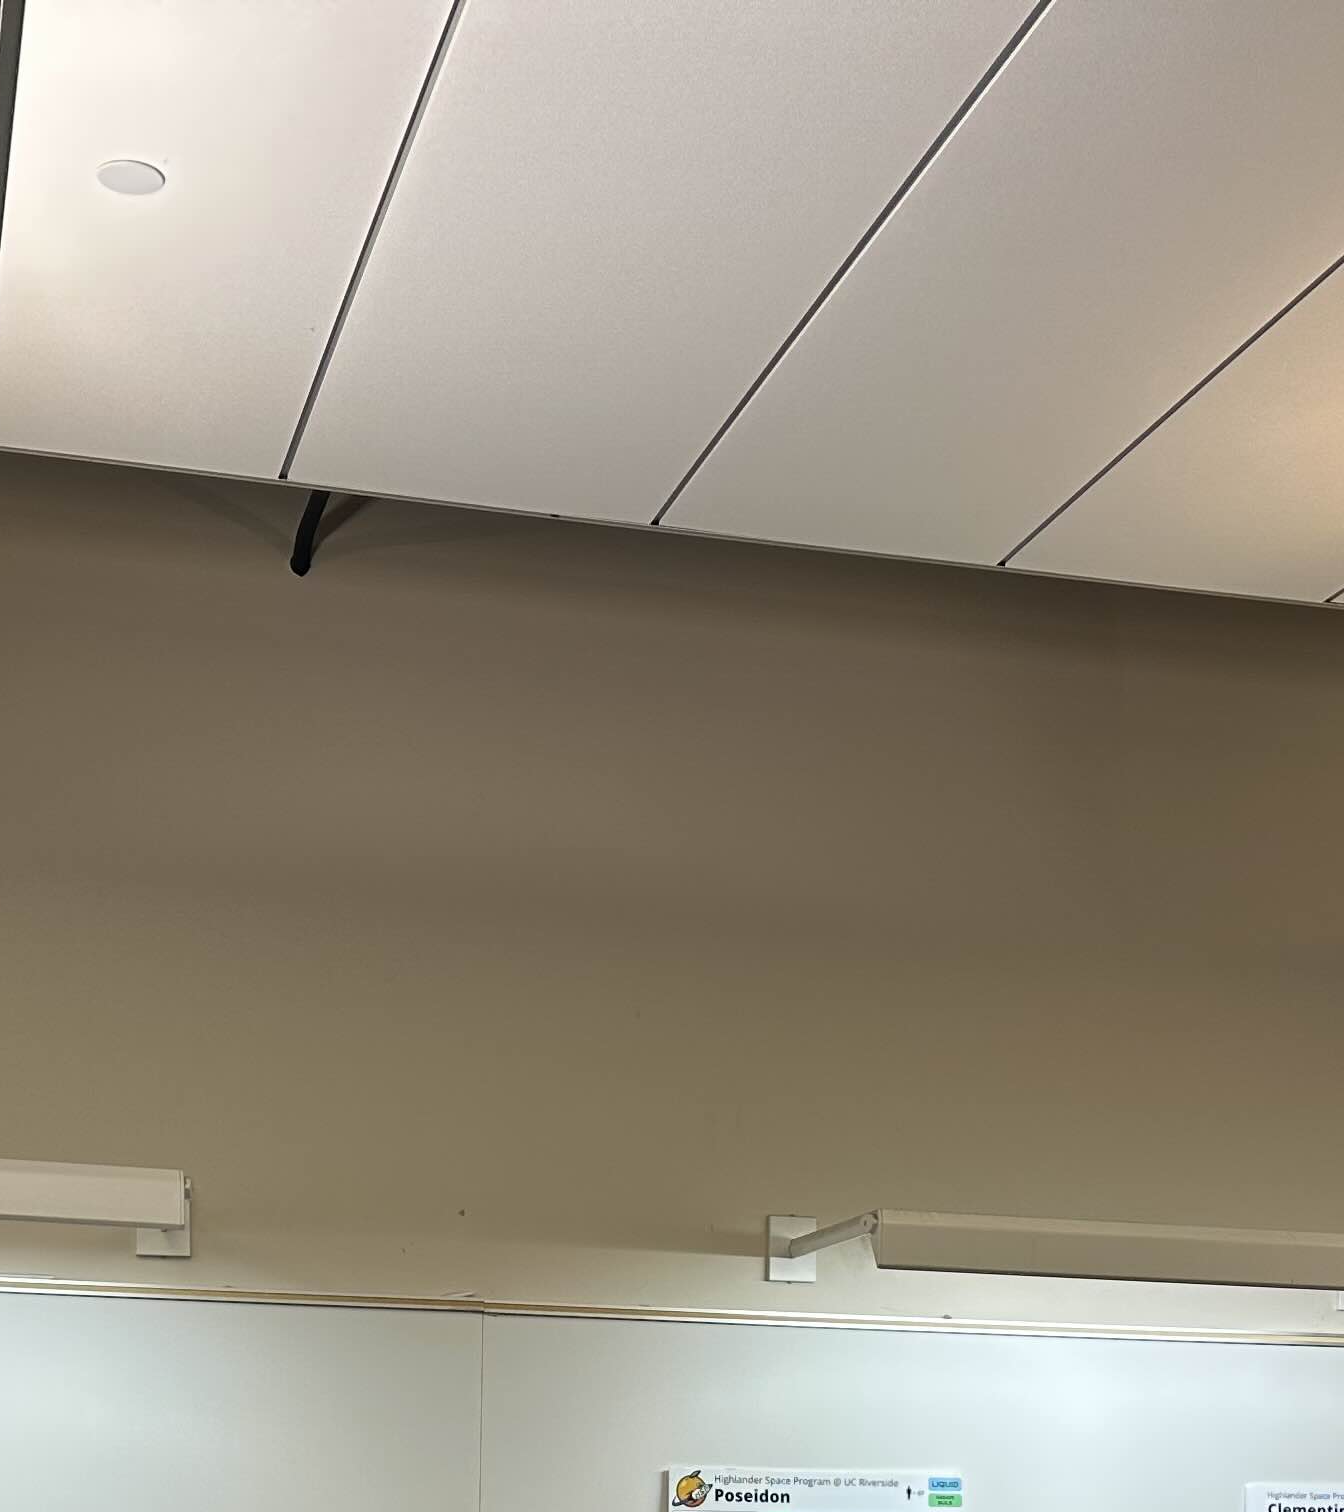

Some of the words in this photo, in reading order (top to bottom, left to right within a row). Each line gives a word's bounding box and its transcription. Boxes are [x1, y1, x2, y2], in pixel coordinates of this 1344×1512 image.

[714, 1475, 763, 1486] Highlander
[765, 1476, 791, 1487] Space
[793, 1476, 831, 1488] Program
[844, 1478, 857, 1487] UC
[859, 1478, 899, 1488] Riverside
[714, 1489, 791, 1504] Poseidon
[1310, 1493, 1330, 1501] Space
